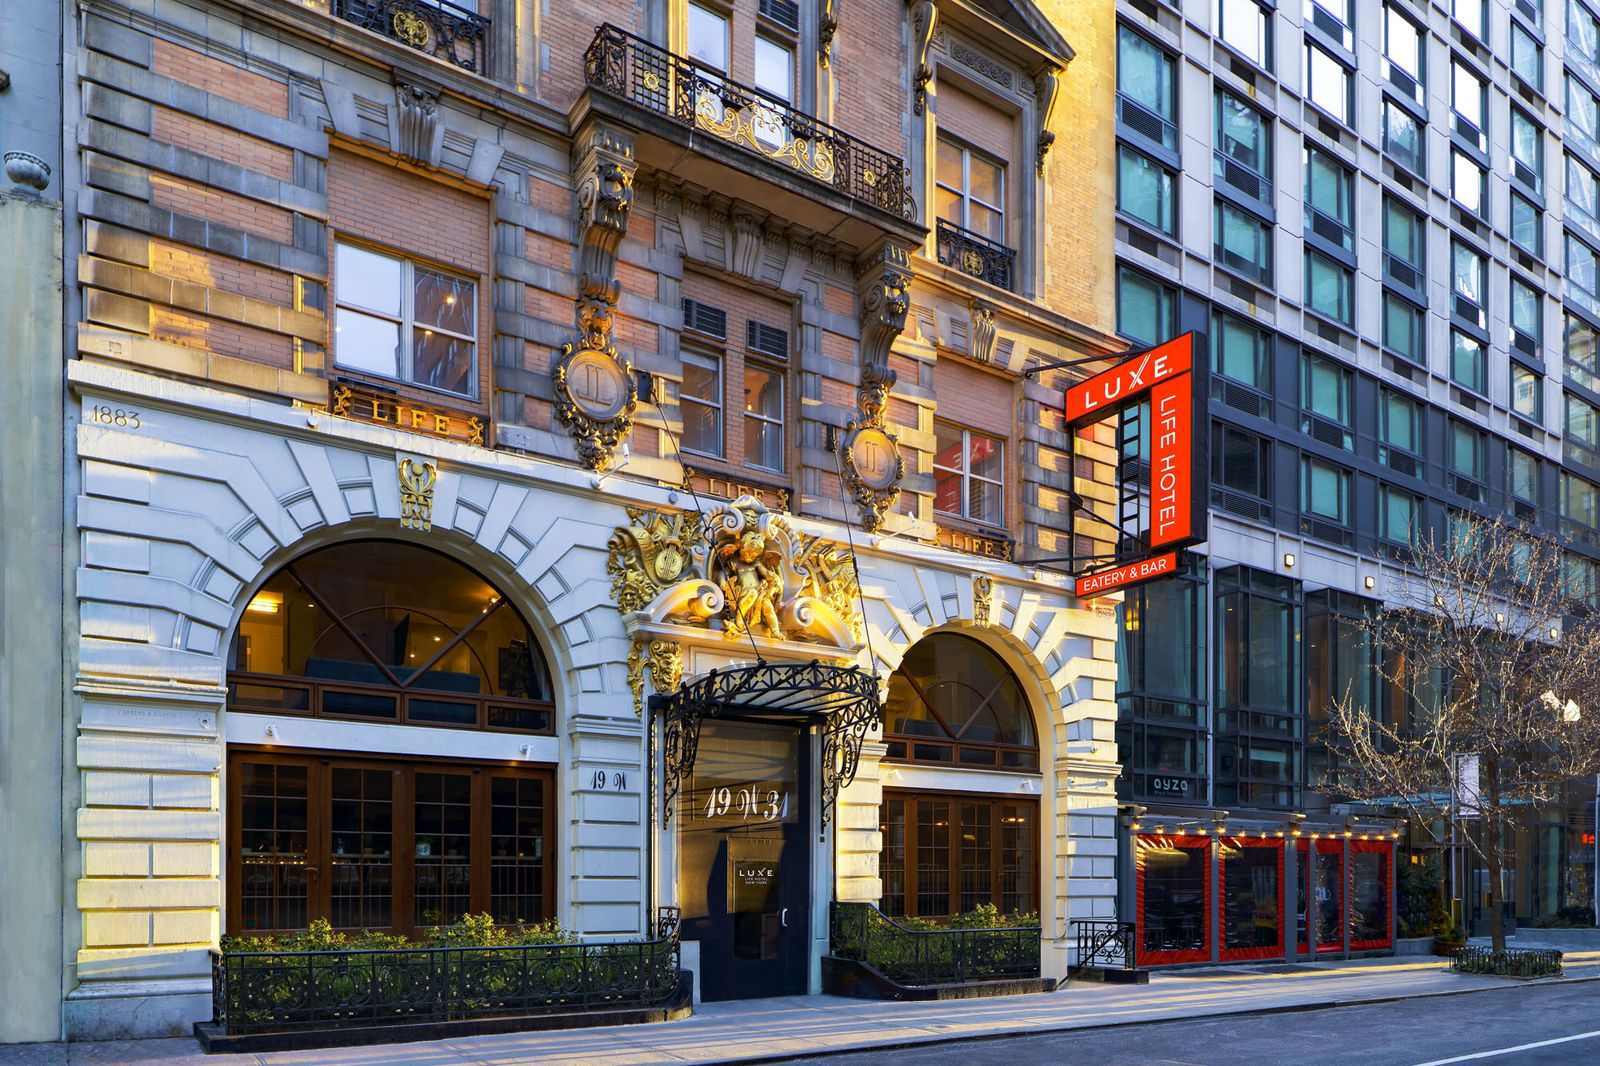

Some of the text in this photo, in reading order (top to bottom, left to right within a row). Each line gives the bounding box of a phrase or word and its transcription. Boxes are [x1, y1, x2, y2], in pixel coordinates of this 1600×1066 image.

[1085, 354, 1168, 409] LUXE
[93, 405, 140, 429] 1883
[371, 400, 450, 435] LIFE
[1160, 395, 1176, 537] LIFE HOTEL
[951, 534, 994, 556] LIFE
[1083, 559, 1167, 591] EATERY & BAR
[590, 770, 606, 790] 19
[1153, 778, 1188, 791] ayza
[704, 784, 789, 820] 19 W 31
[739, 867, 774, 877] LUXE
